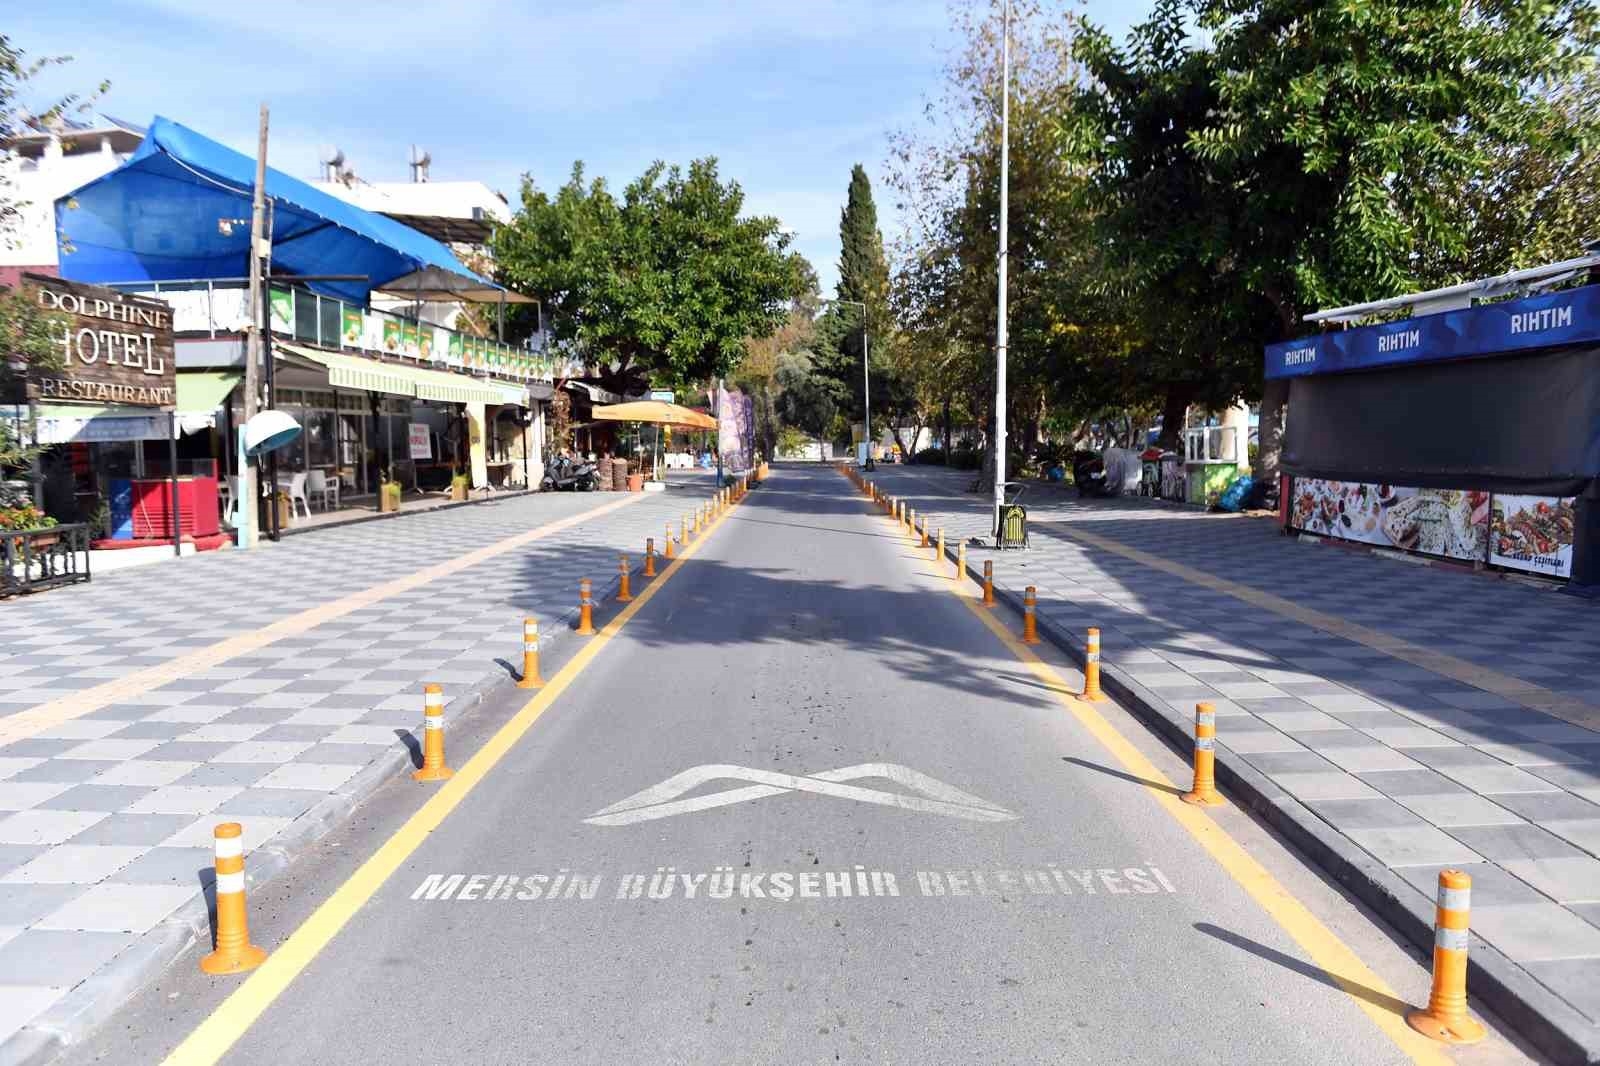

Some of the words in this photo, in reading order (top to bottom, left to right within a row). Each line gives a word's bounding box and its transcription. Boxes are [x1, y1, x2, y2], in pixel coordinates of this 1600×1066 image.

[38, 289, 168, 329] DOLPHINE
[1511, 305, 1572, 334] RIHTIM
[1378, 329, 1420, 352] RIHTIM
[1285, 347, 1316, 366] RIHTIM
[40, 377, 172, 405] RESTAURANT
[409, 868, 602, 900] MERSİN
